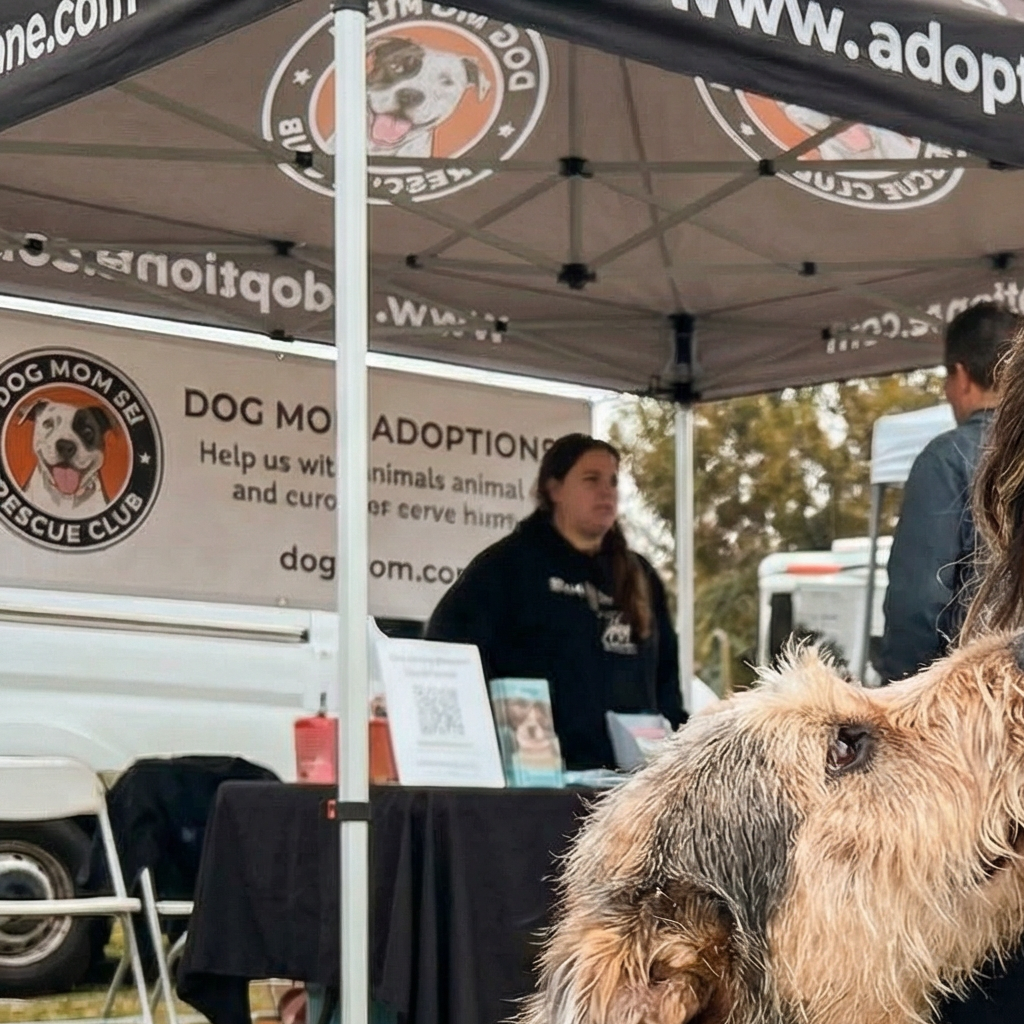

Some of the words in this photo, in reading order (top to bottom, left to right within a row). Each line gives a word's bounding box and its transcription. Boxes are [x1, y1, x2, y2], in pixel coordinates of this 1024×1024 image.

[50, 359, 113, 394] MOM
[184, 387, 264, 426] DOG
[276, 400, 333, 434] MO
[200, 439, 257, 475] Help
[264, 453, 291, 473] us
[367, 462, 445, 491] nimals
[232, 480, 277, 505] and
[88, 493, 144, 541] CLUB
